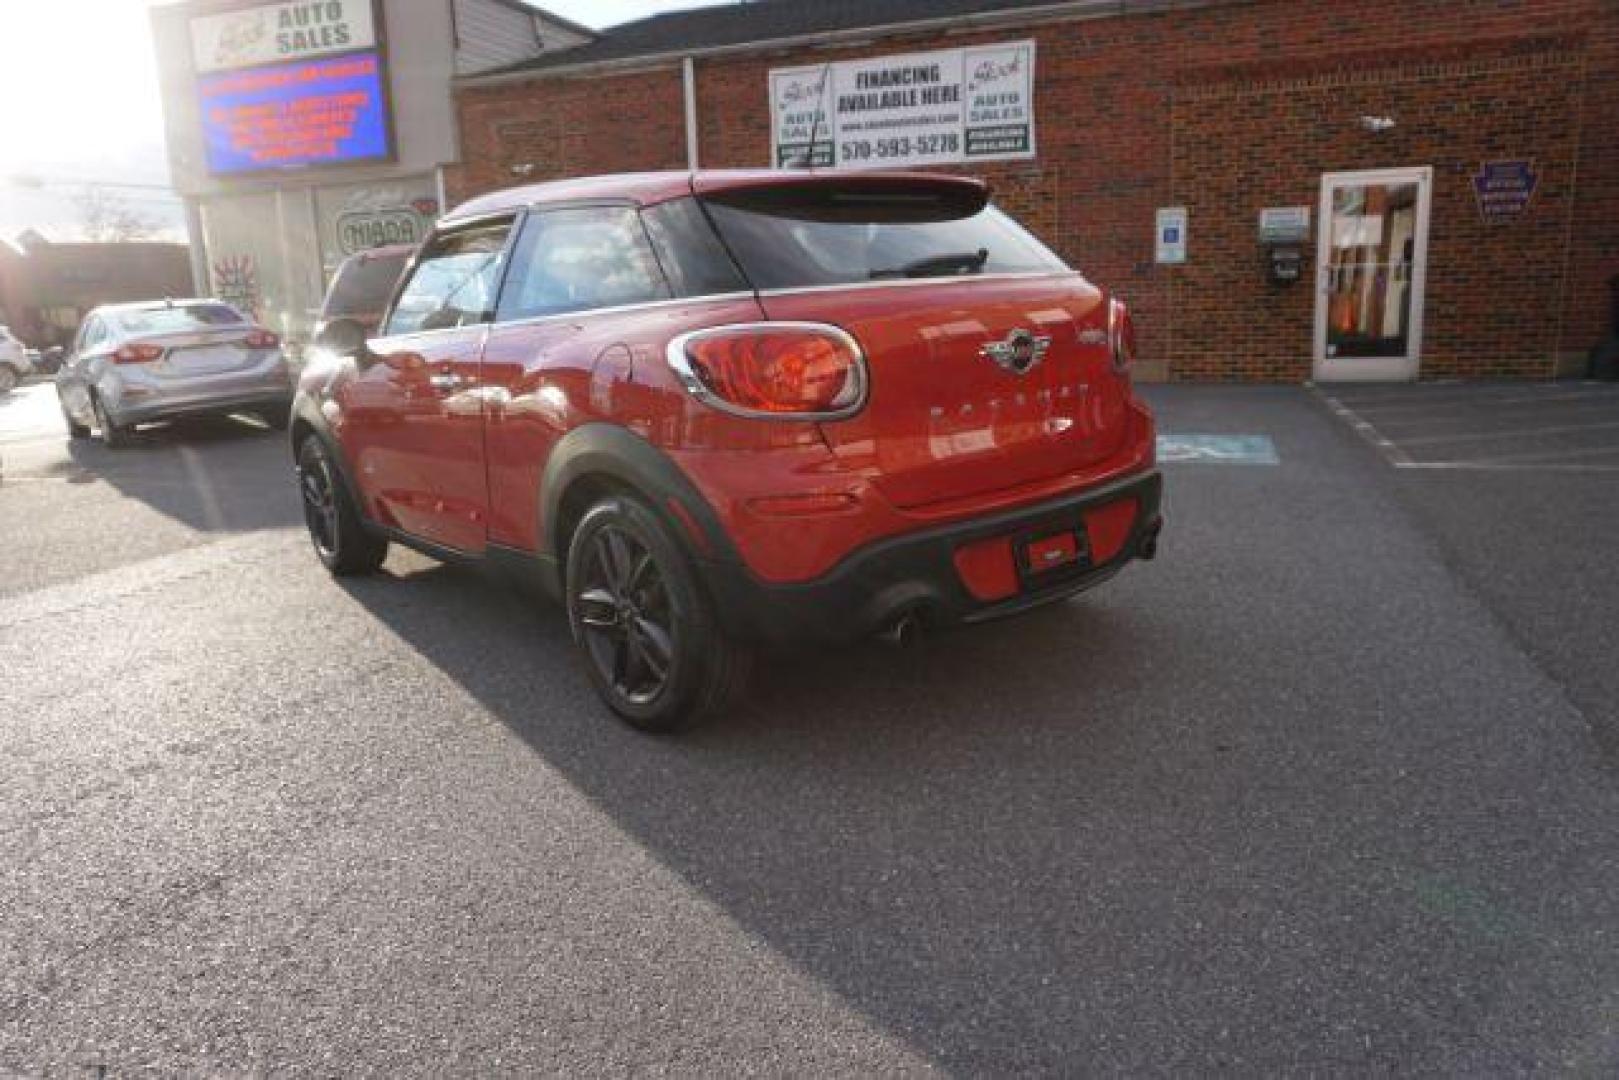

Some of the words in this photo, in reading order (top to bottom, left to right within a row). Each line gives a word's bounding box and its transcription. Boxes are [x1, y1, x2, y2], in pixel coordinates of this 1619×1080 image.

[279, 1, 343, 28] AUTO
[277, 23, 350, 53] SALES
[856, 64, 940, 89] FINANCING
[838, 88, 917, 113] AVAILABLE
[921, 83, 960, 105] HERE
